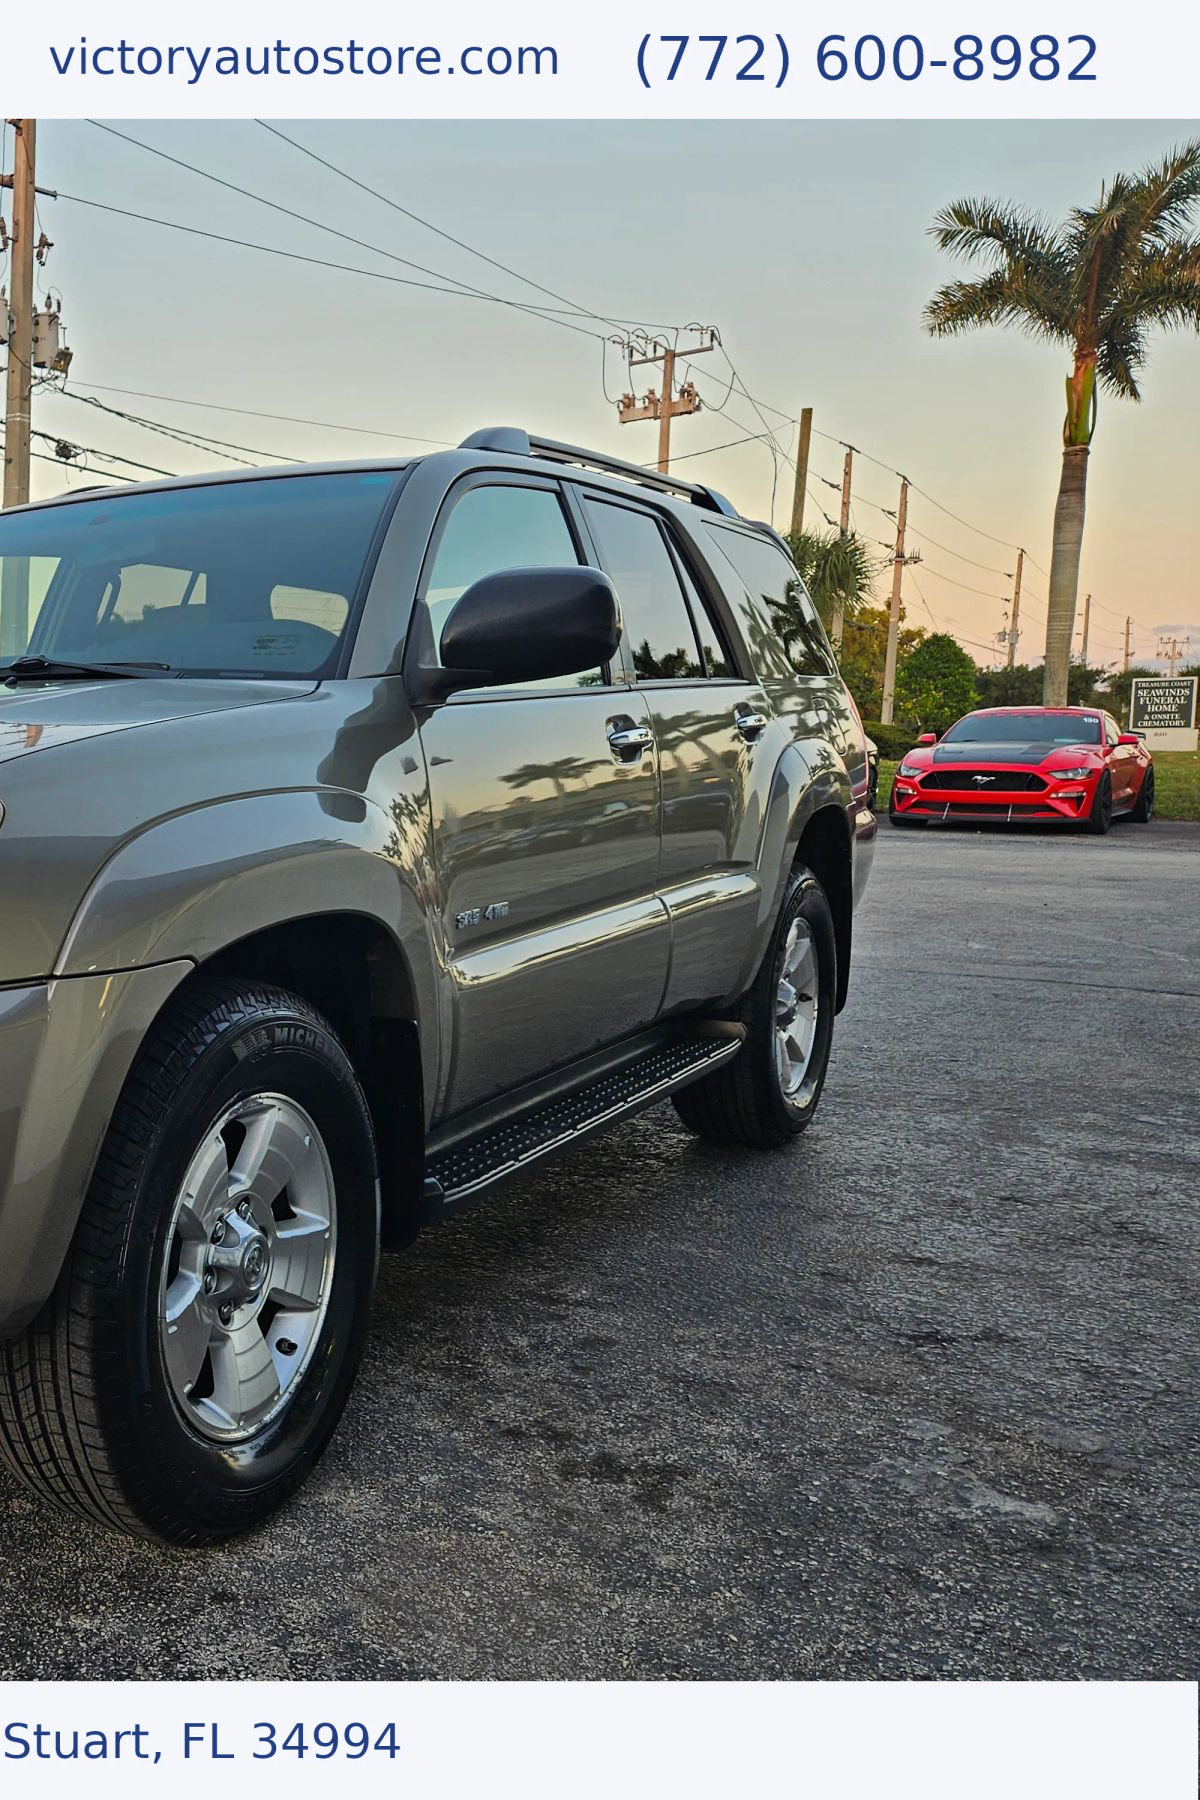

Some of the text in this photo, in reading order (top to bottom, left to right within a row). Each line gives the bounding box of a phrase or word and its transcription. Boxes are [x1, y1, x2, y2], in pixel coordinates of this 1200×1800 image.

[1137, 687, 1190, 697] SEAWINDS
[1139, 696, 1188, 705] FUNERAL
[1147, 704, 1179, 712] HOME
